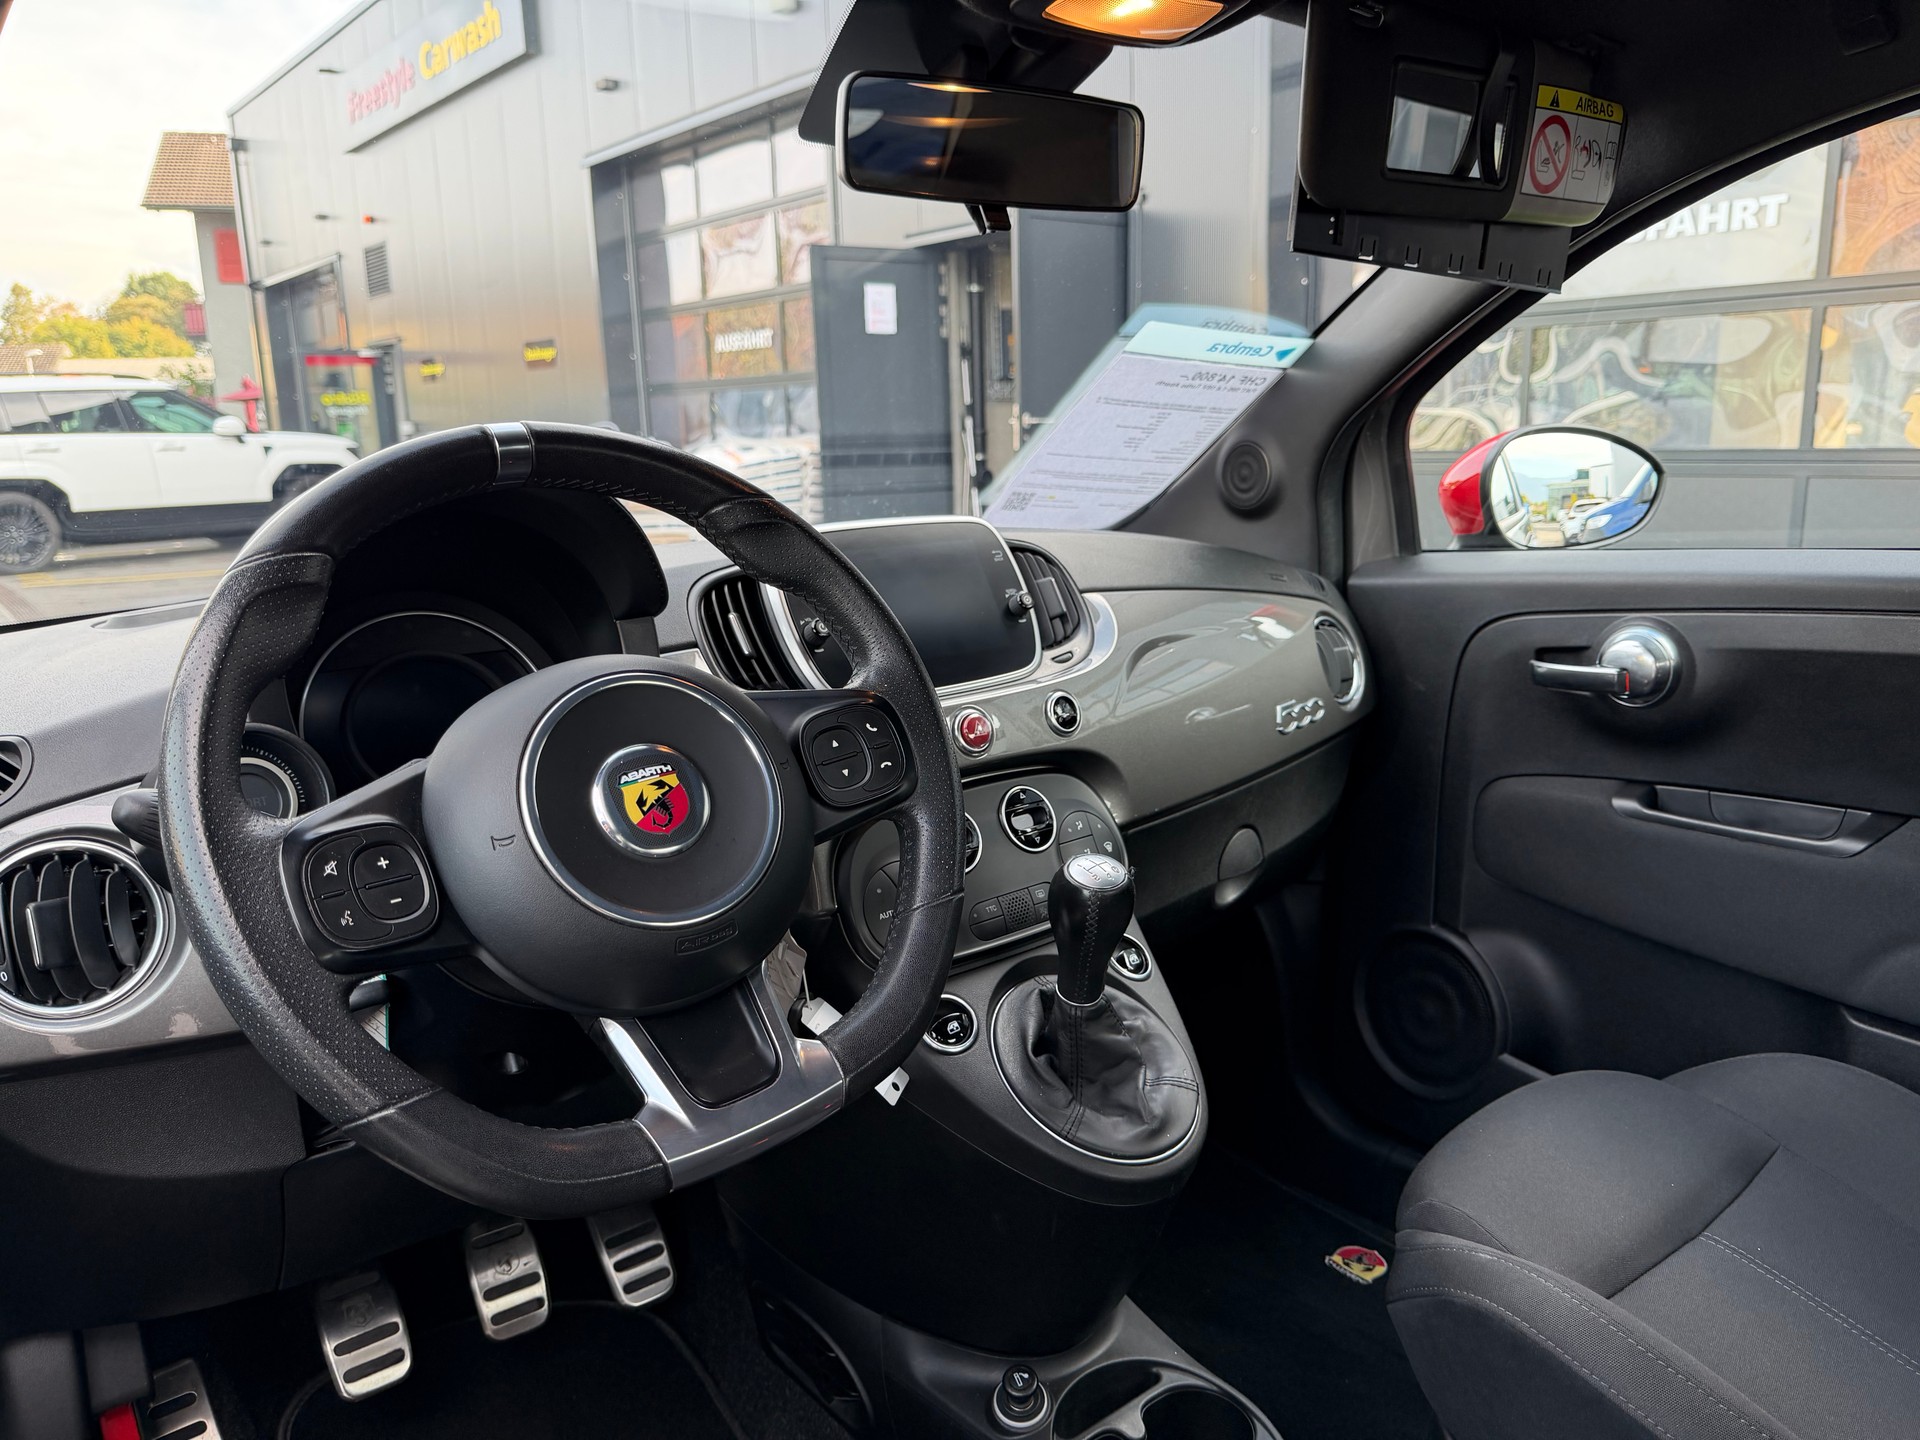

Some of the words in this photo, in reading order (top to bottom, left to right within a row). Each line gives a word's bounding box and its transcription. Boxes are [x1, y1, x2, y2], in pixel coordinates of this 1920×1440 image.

[419, 0, 502, 80] Carwash
[1576, 96, 1614, 117] AIRBAG
[620, 764, 673, 784] ABARTH
[879, 909, 894, 921] AUT
[985, 905, 998, 913] TTC
